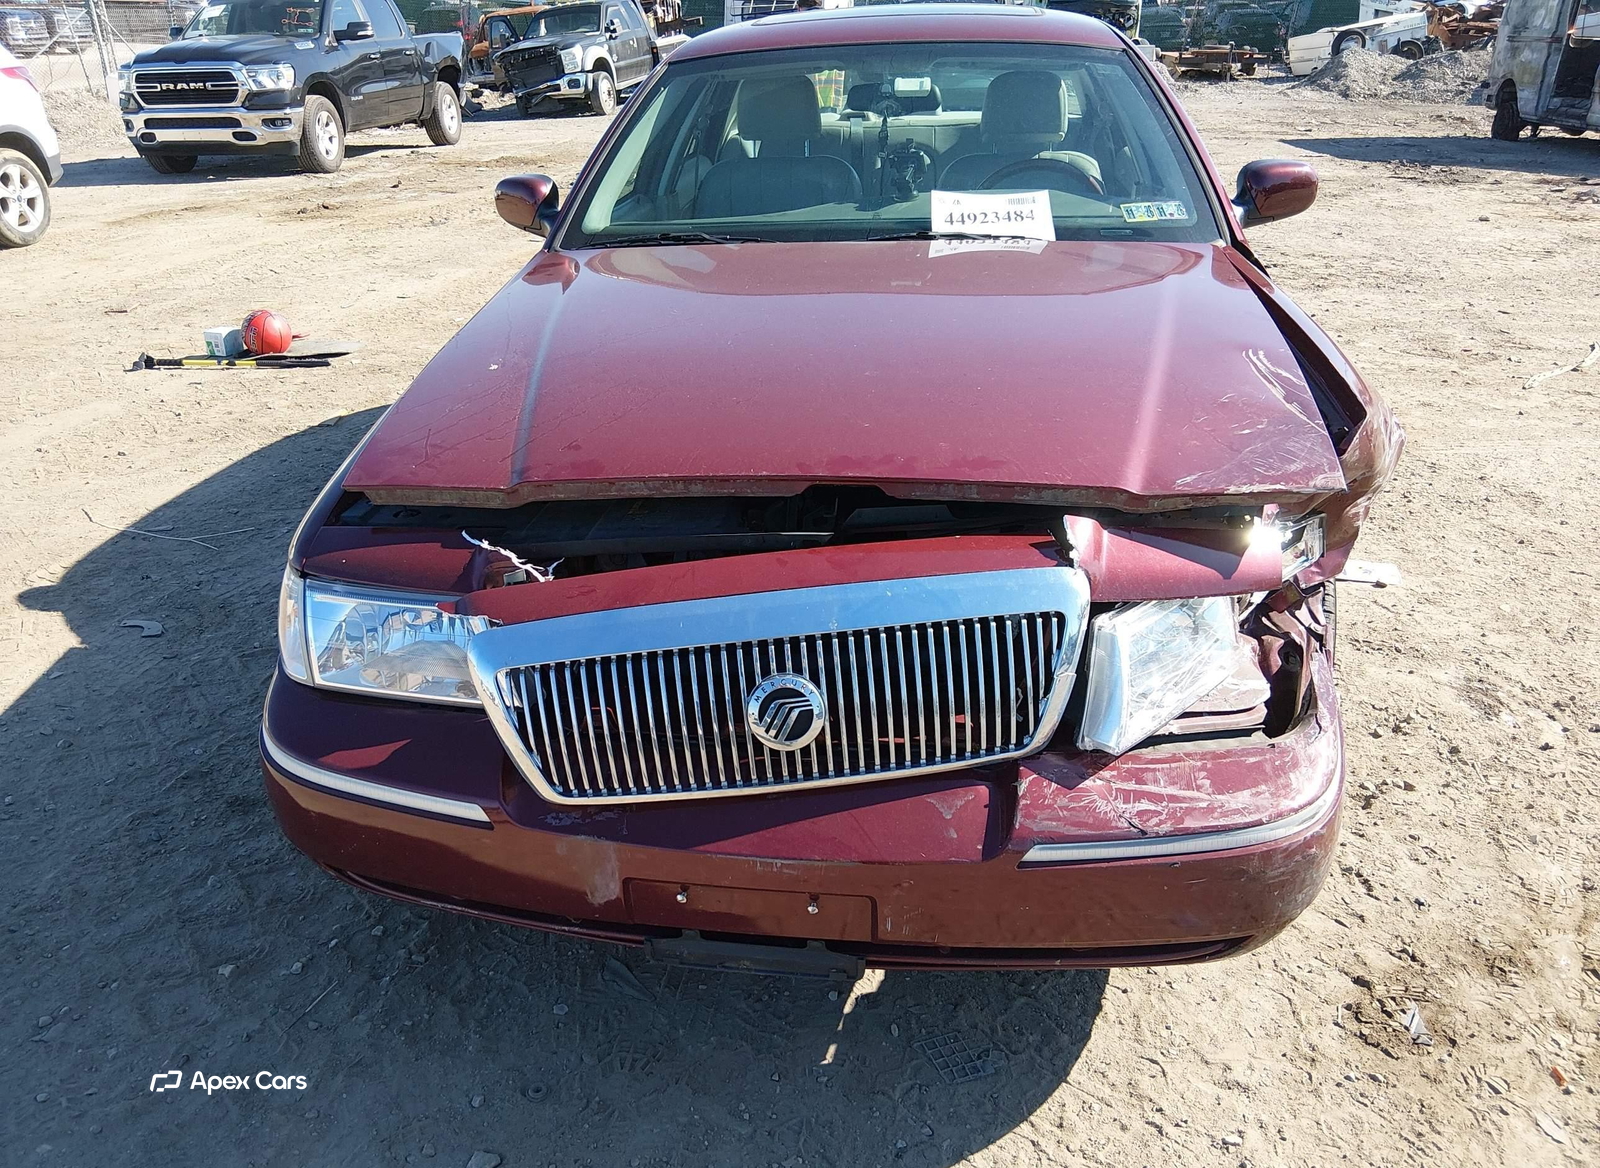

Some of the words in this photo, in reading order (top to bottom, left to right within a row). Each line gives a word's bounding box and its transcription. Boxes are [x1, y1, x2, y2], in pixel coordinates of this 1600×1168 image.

[944, 209, 1035, 226] 44923484
[1125, 208, 1136, 219] 11
[1156, 206, 1168, 217] 11
[754, 678, 815, 704] MERCURY
